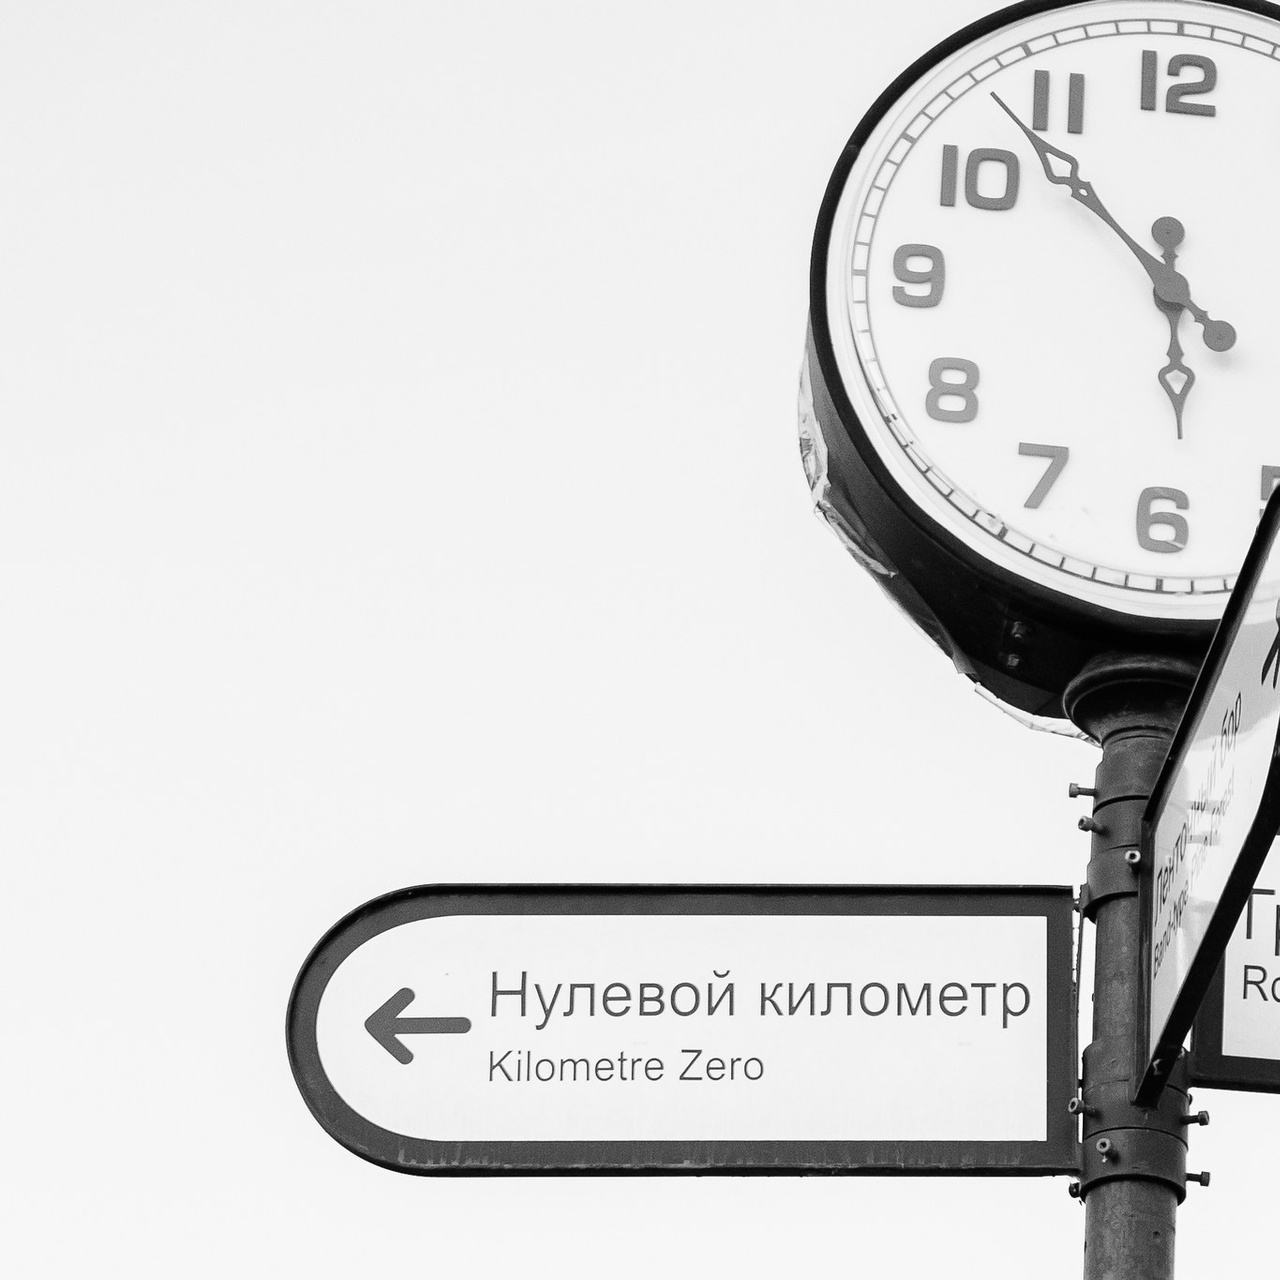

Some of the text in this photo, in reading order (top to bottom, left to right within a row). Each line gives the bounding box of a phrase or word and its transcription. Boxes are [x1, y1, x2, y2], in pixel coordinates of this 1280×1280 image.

[1033, 70, 1086, 134] 11
[1140, 50, 1217, 117] 12
[940, 144, 1020, 211] 10
[893, 244, 945, 308] 9
[926, 358, 979, 423] 8
[1018, 443, 1070, 509] 7
[1136, 487, 1189, 553] 6
[1220, 691, 1242, 769] бор
[490, 969, 1031, 1030] Нулевой километр
[489, 1049, 764, 1082] Kilometre Zero
